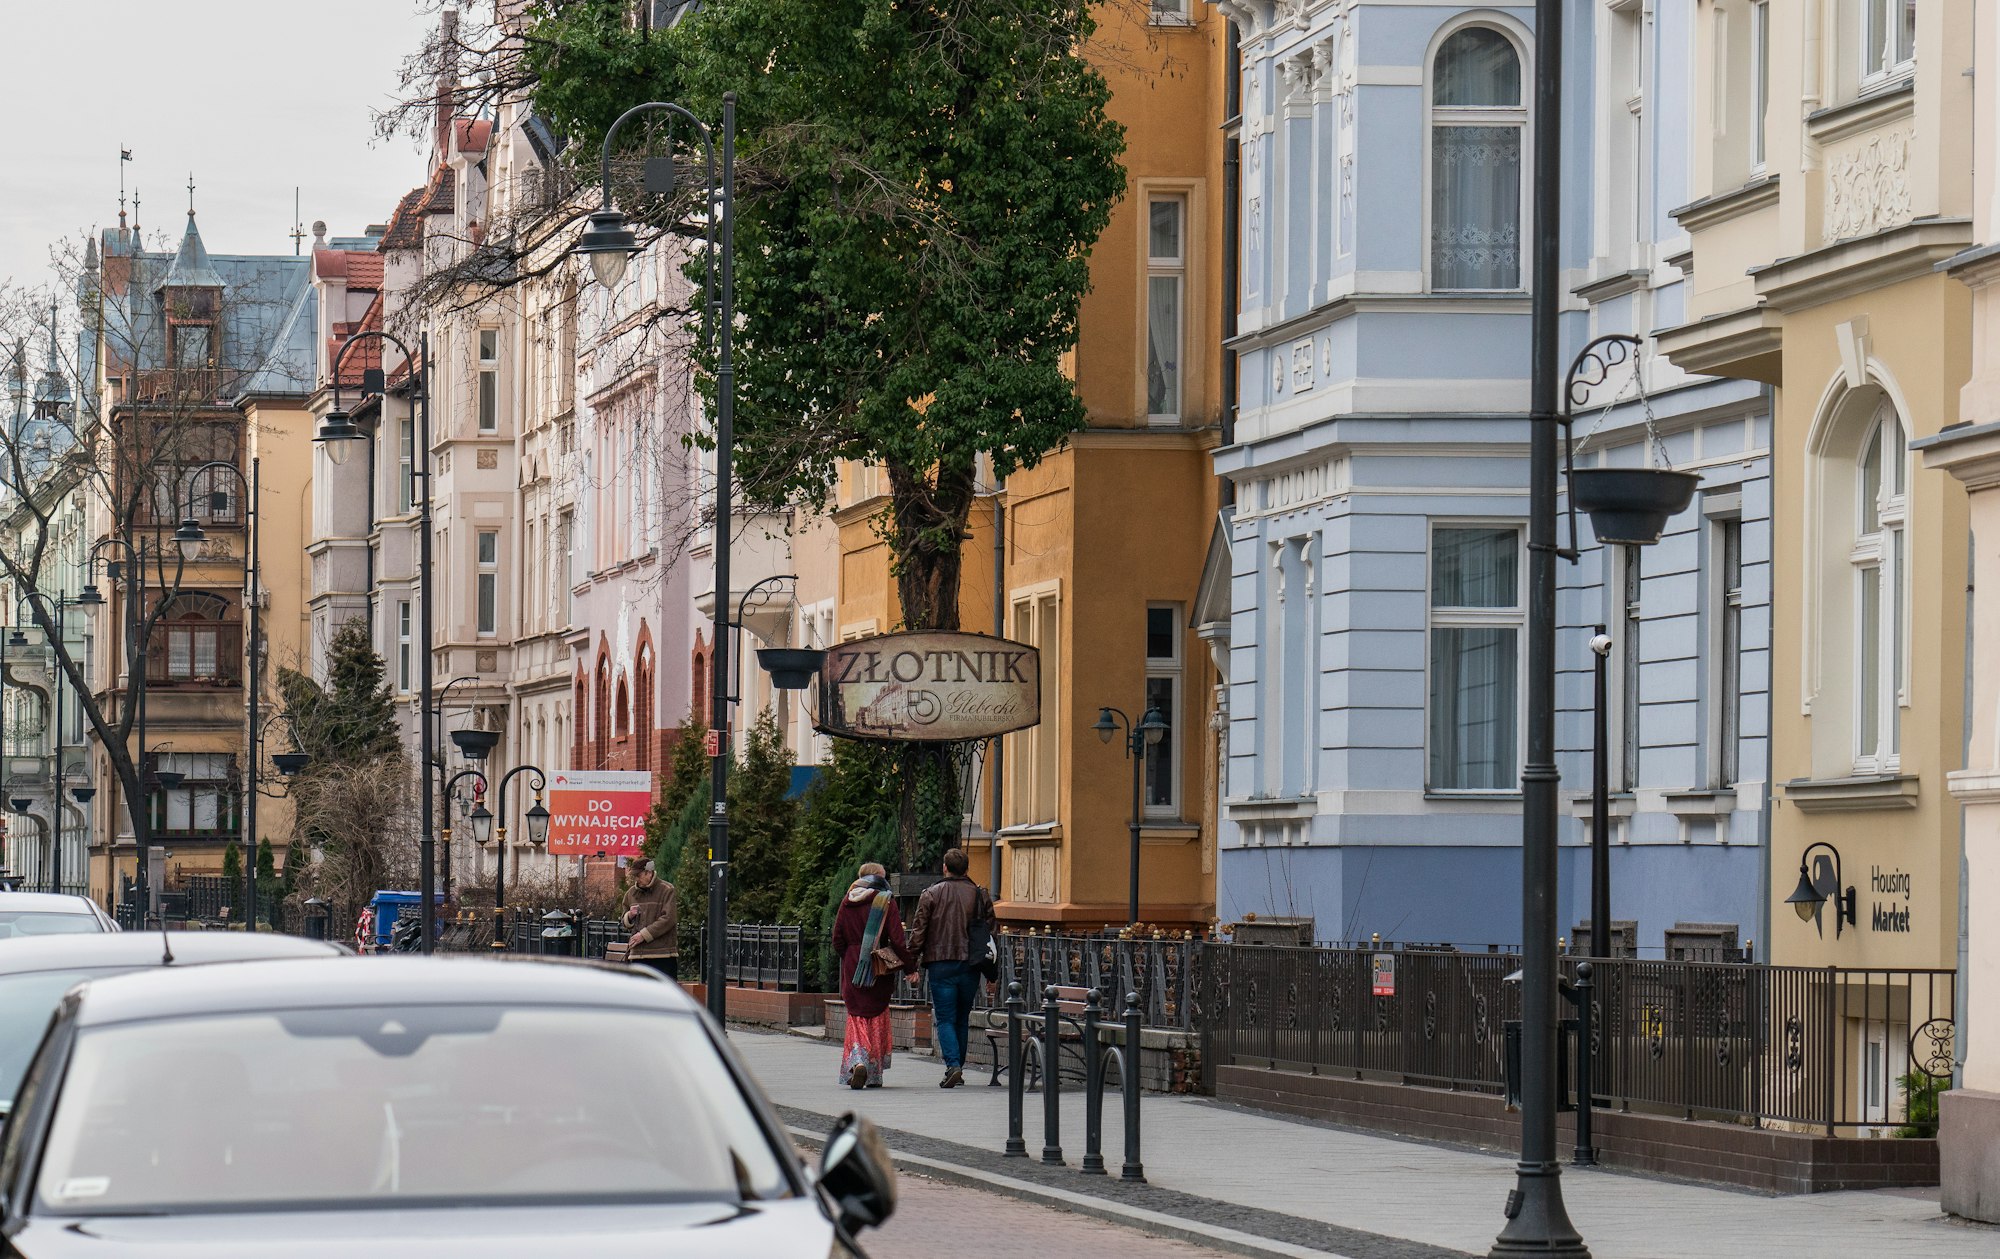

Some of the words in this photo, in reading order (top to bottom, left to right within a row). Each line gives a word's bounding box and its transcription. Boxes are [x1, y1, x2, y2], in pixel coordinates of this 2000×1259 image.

[838, 651, 1028, 683] ZŁOTNIK
[974, 714, 1015, 722] JUBILERSKA
[588, 800, 613, 812] DO
[554, 815, 645, 830] WYNAJĘCIA
[566, 834, 590, 845] 514
[595, 834, 618, 846] 139
[621, 835, 645, 846] 218
[1871, 865, 1910, 900] Housing
[1872, 902, 1910, 933] Market
